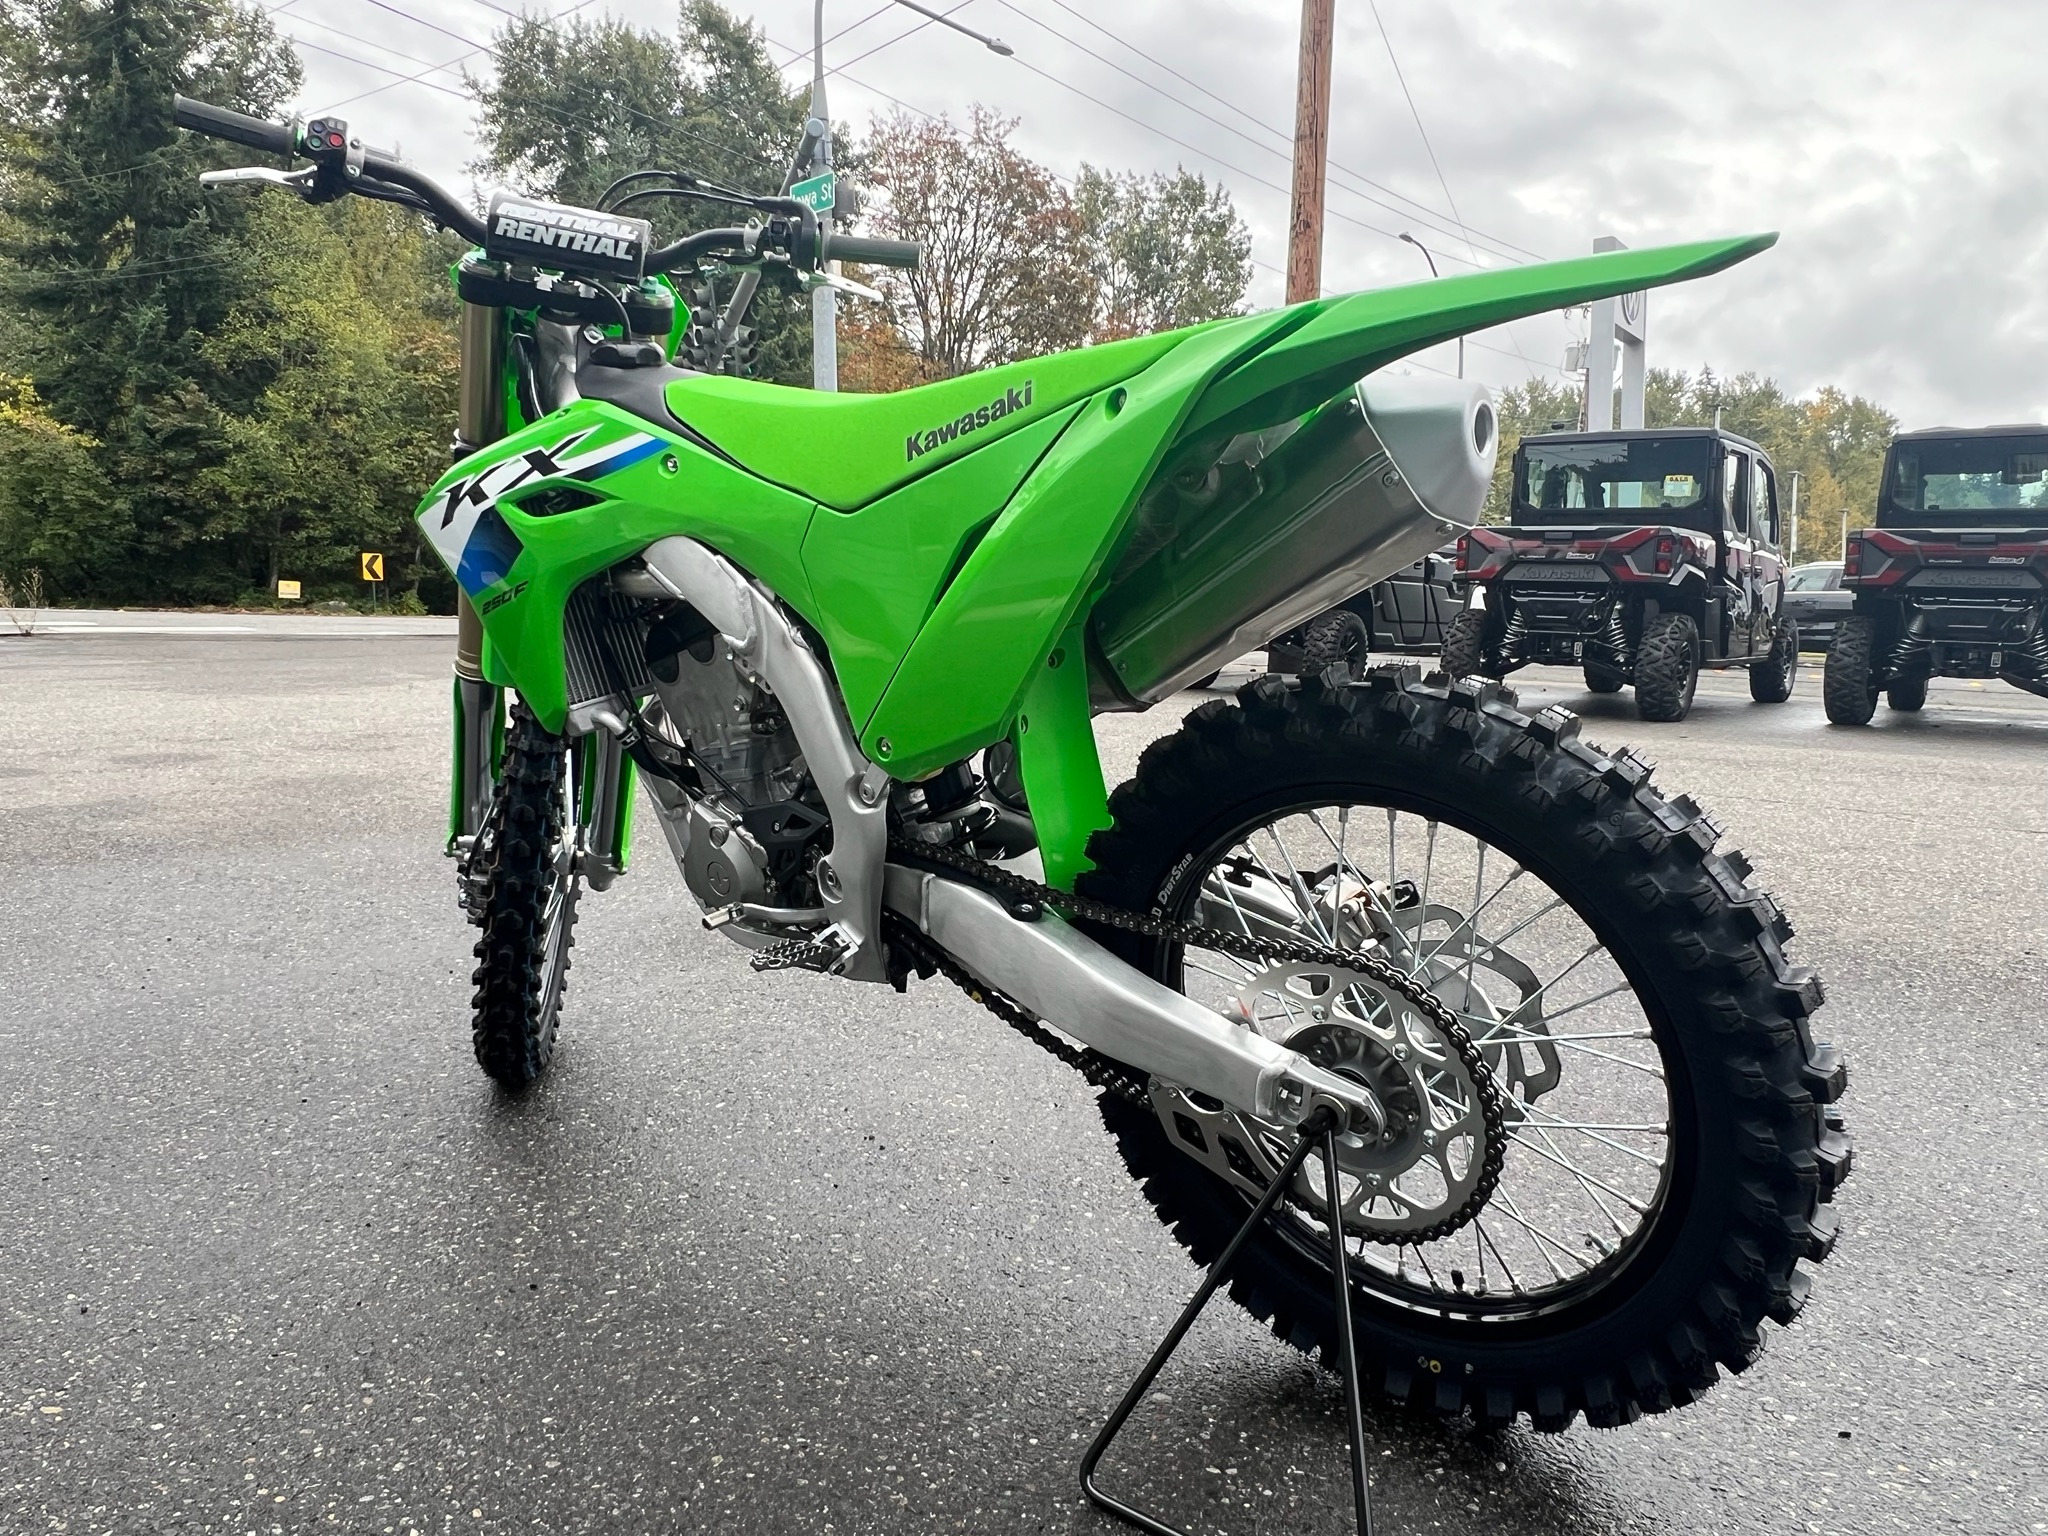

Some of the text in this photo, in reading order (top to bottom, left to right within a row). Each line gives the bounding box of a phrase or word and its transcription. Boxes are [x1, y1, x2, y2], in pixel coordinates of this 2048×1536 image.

[820, 182, 832, 202] St
[495, 217, 633, 262] RENTHAL
[906, 379, 1032, 462] Kawasaki
[440, 431, 590, 531] KX
[1520, 566, 1595, 580] Kawasaki
